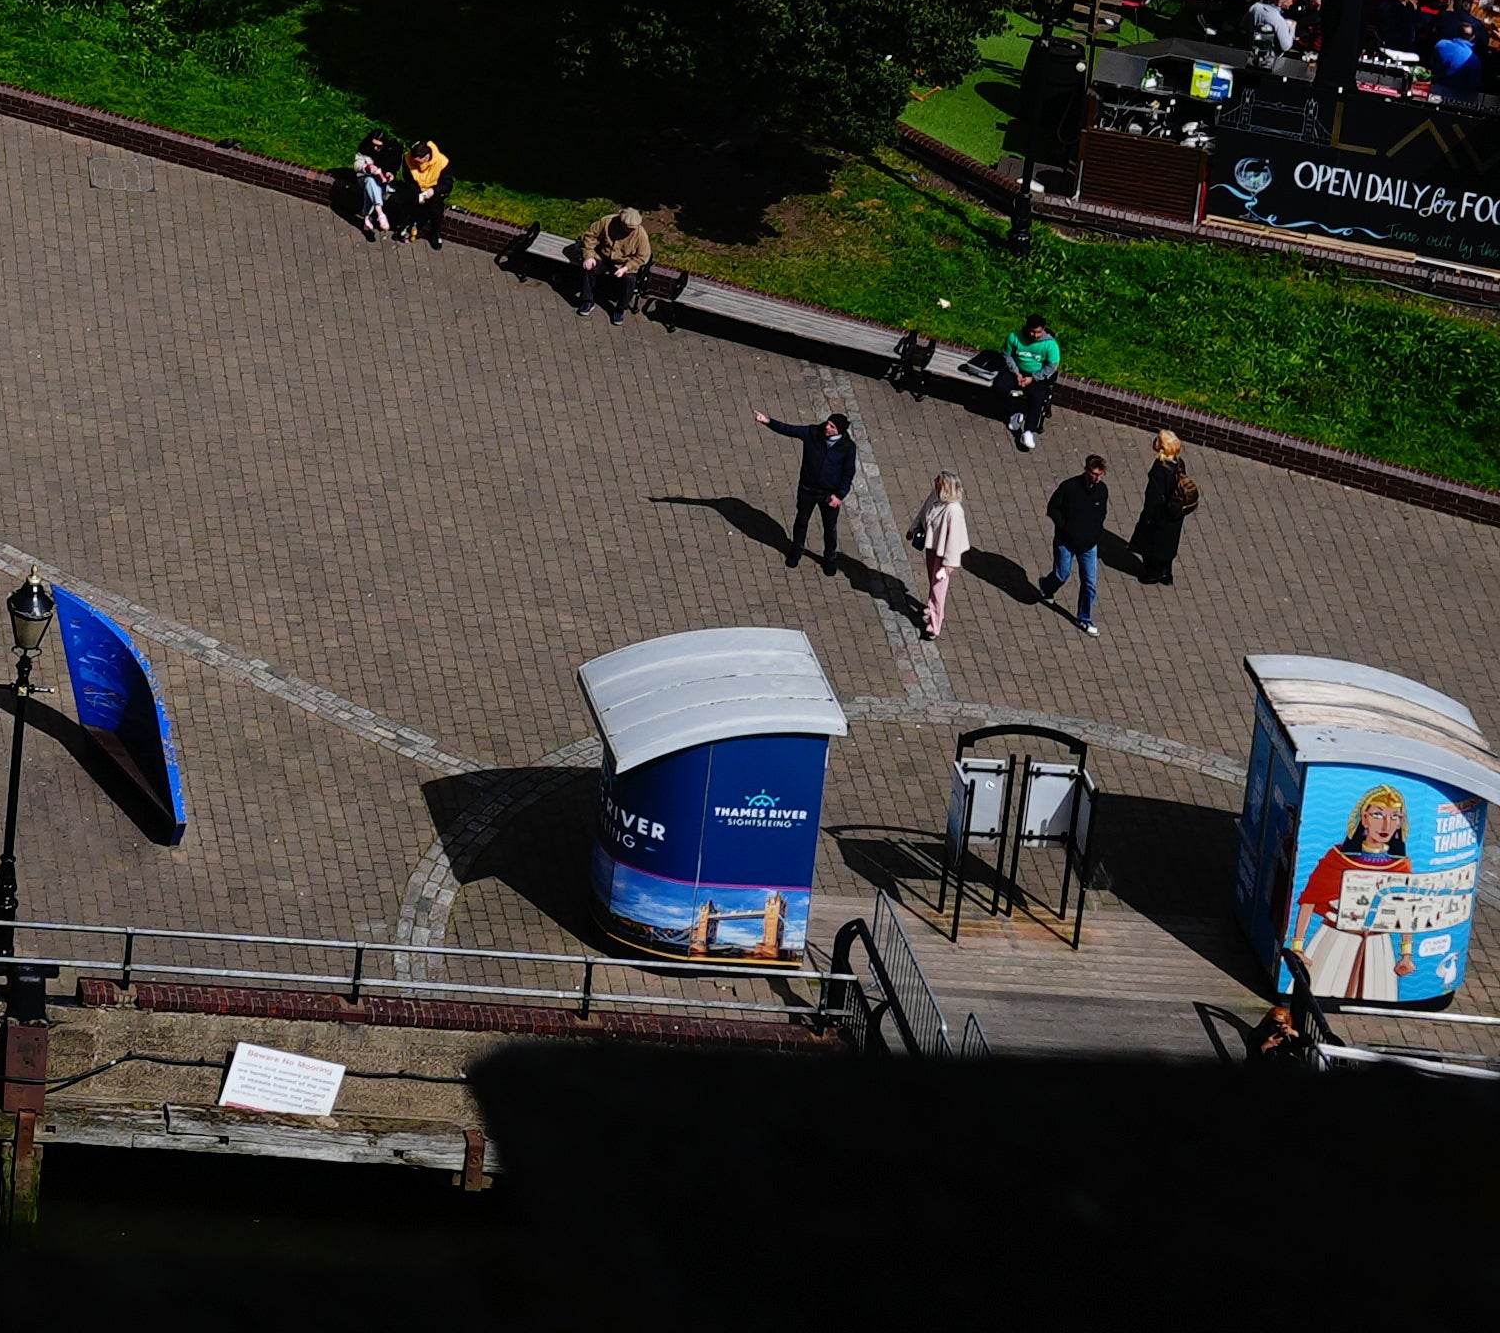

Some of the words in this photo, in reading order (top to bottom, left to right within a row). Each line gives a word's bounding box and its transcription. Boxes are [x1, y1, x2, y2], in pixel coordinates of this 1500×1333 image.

[1293, 160, 1362, 200] OPEN
[1365, 173, 1431, 210] DAILY
[1418, 186, 1457, 223] for
[1458, 236, 1474, 259] by
[606, 796, 666, 842] RIVER
[714, 806, 766, 818] THAMES
[770, 809, 808, 821] RIVER
[727, 818, 792, 829] SIGHTSEEING
[247, 1049, 280, 1063] Beware
[282, 1057, 295, 1067] No
[297, 1060, 334, 1076] Mooring
